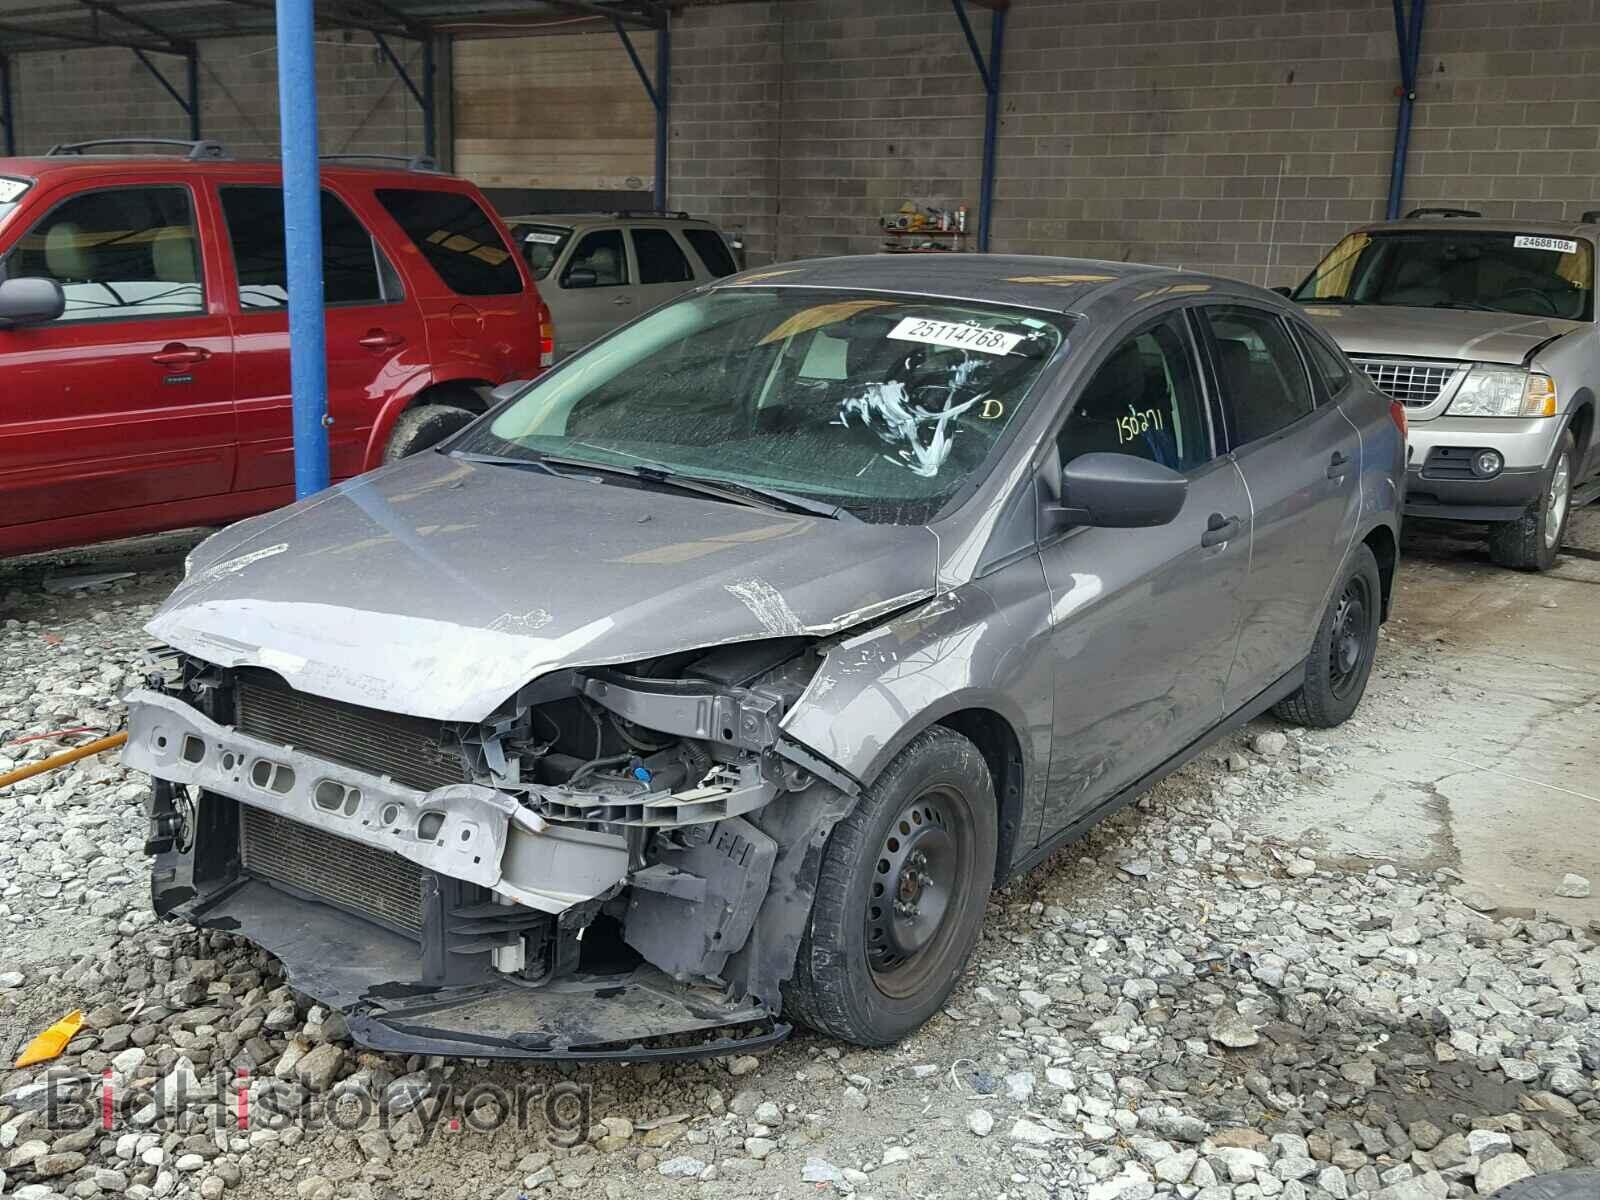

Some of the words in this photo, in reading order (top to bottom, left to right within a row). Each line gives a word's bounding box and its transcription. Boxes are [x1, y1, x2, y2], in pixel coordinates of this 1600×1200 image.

[907, 319, 1005, 348] 25114768
[978, 399, 1004, 419] D
[1116, 408, 1164, 445] 150271
